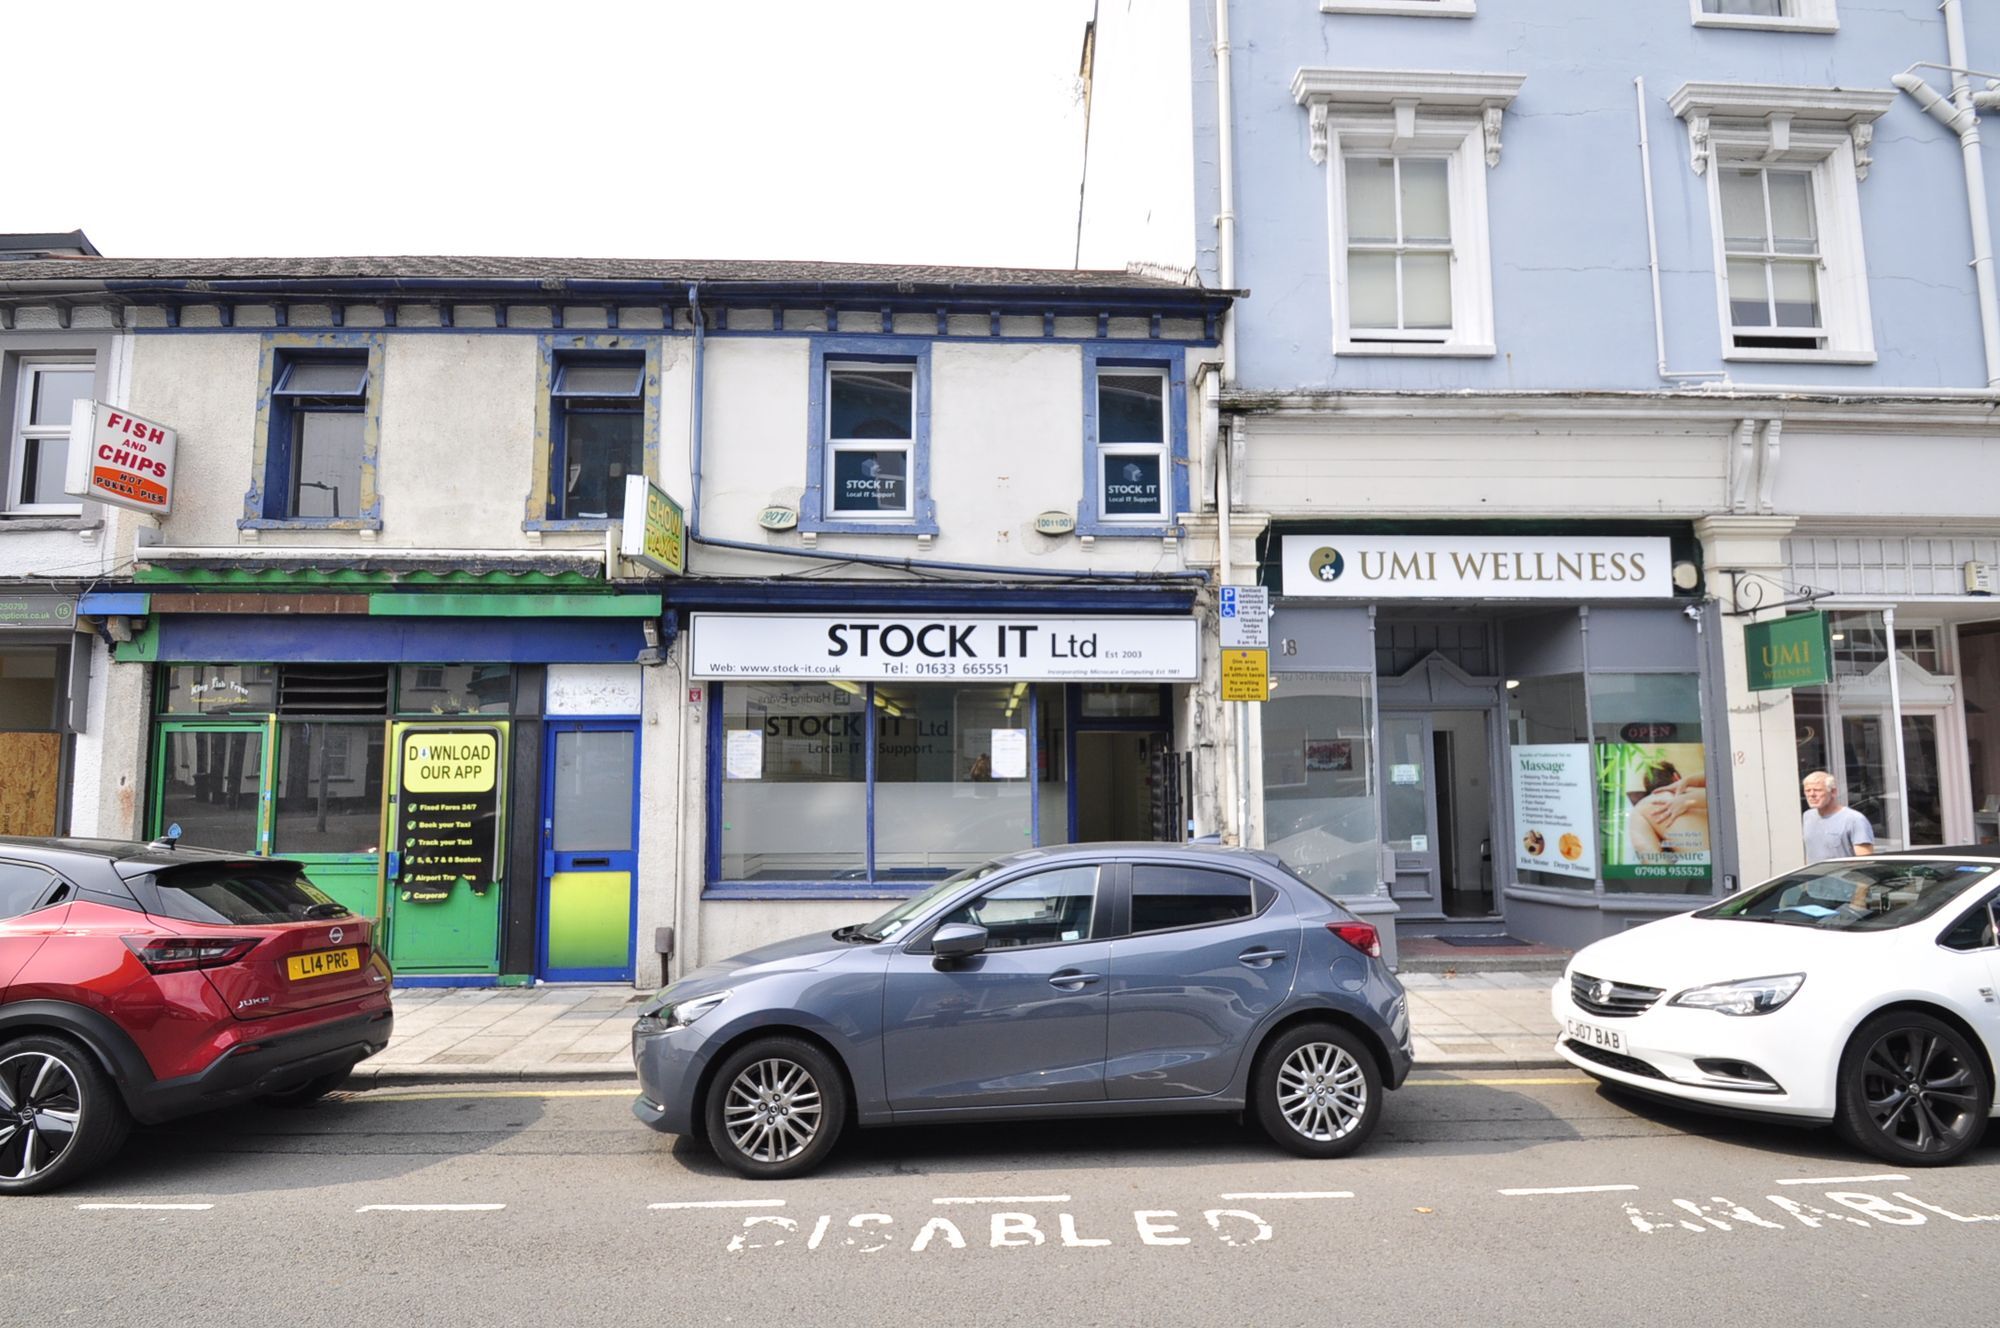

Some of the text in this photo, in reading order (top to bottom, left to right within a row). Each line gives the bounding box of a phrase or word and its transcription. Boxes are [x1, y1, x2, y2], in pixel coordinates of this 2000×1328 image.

[107, 413, 165, 445] FISH
[121, 439, 148, 453] AND
[98, 444, 167, 478] CHIPS
[120, 474, 144, 485] HOT
[846, 480, 896, 489] STOCK IT
[871, 491, 896, 499] Support
[1108, 485, 1157, 494] STOCK IT
[1133, 496, 1158, 504] Support
[646, 523, 680, 566] TAXIS
[1358, 550, 1647, 582] UMI WELLNESS
[1224, 589, 1234, 601] P
[59, 607, 68, 616] 15
[827, 623, 1143, 659] STOCK IT Ltd Est 2003
[1281, 638, 1297, 656] 18
[1762, 640, 1809, 668] UMI
[709, 663, 841, 674] Web: www.stock-it.co.uk
[882, 662, 1009, 675] Tel: 01633 665551
[1048, 669, 1088, 677] Incorporating
[1121, 669, 1154, 677] Computing
[767, 716, 949, 738] STOCK IT Ltd
[1628, 725, 1671, 738] OPEN
[808, 742, 933, 756] Local IT Support
[421, 765, 482, 780] OUR APP
[1520, 759, 1565, 774] Massage
[420, 803, 478, 811] Fixed Fares 24/7
[418, 821, 438, 829] Book
[457, 838, 473, 846] Taxi
[454, 856, 482, 864] Seaters
[1631, 852, 1704, 863] Acupressure
[1533, 858, 1549, 866] Stone
[1553, 861, 1570, 870] Deep
[1571, 863, 1590, 871] Tissue
[415, 874, 442, 882] Airport
[1634, 866, 1705, 877] 07908 955528
[301, 951, 350, 975] L14 PRG
[237, 996, 270, 1010] JUKE
[1594, 1028, 1621, 1049] BAB
[726, 1209, 1274, 1252] DISABLED
